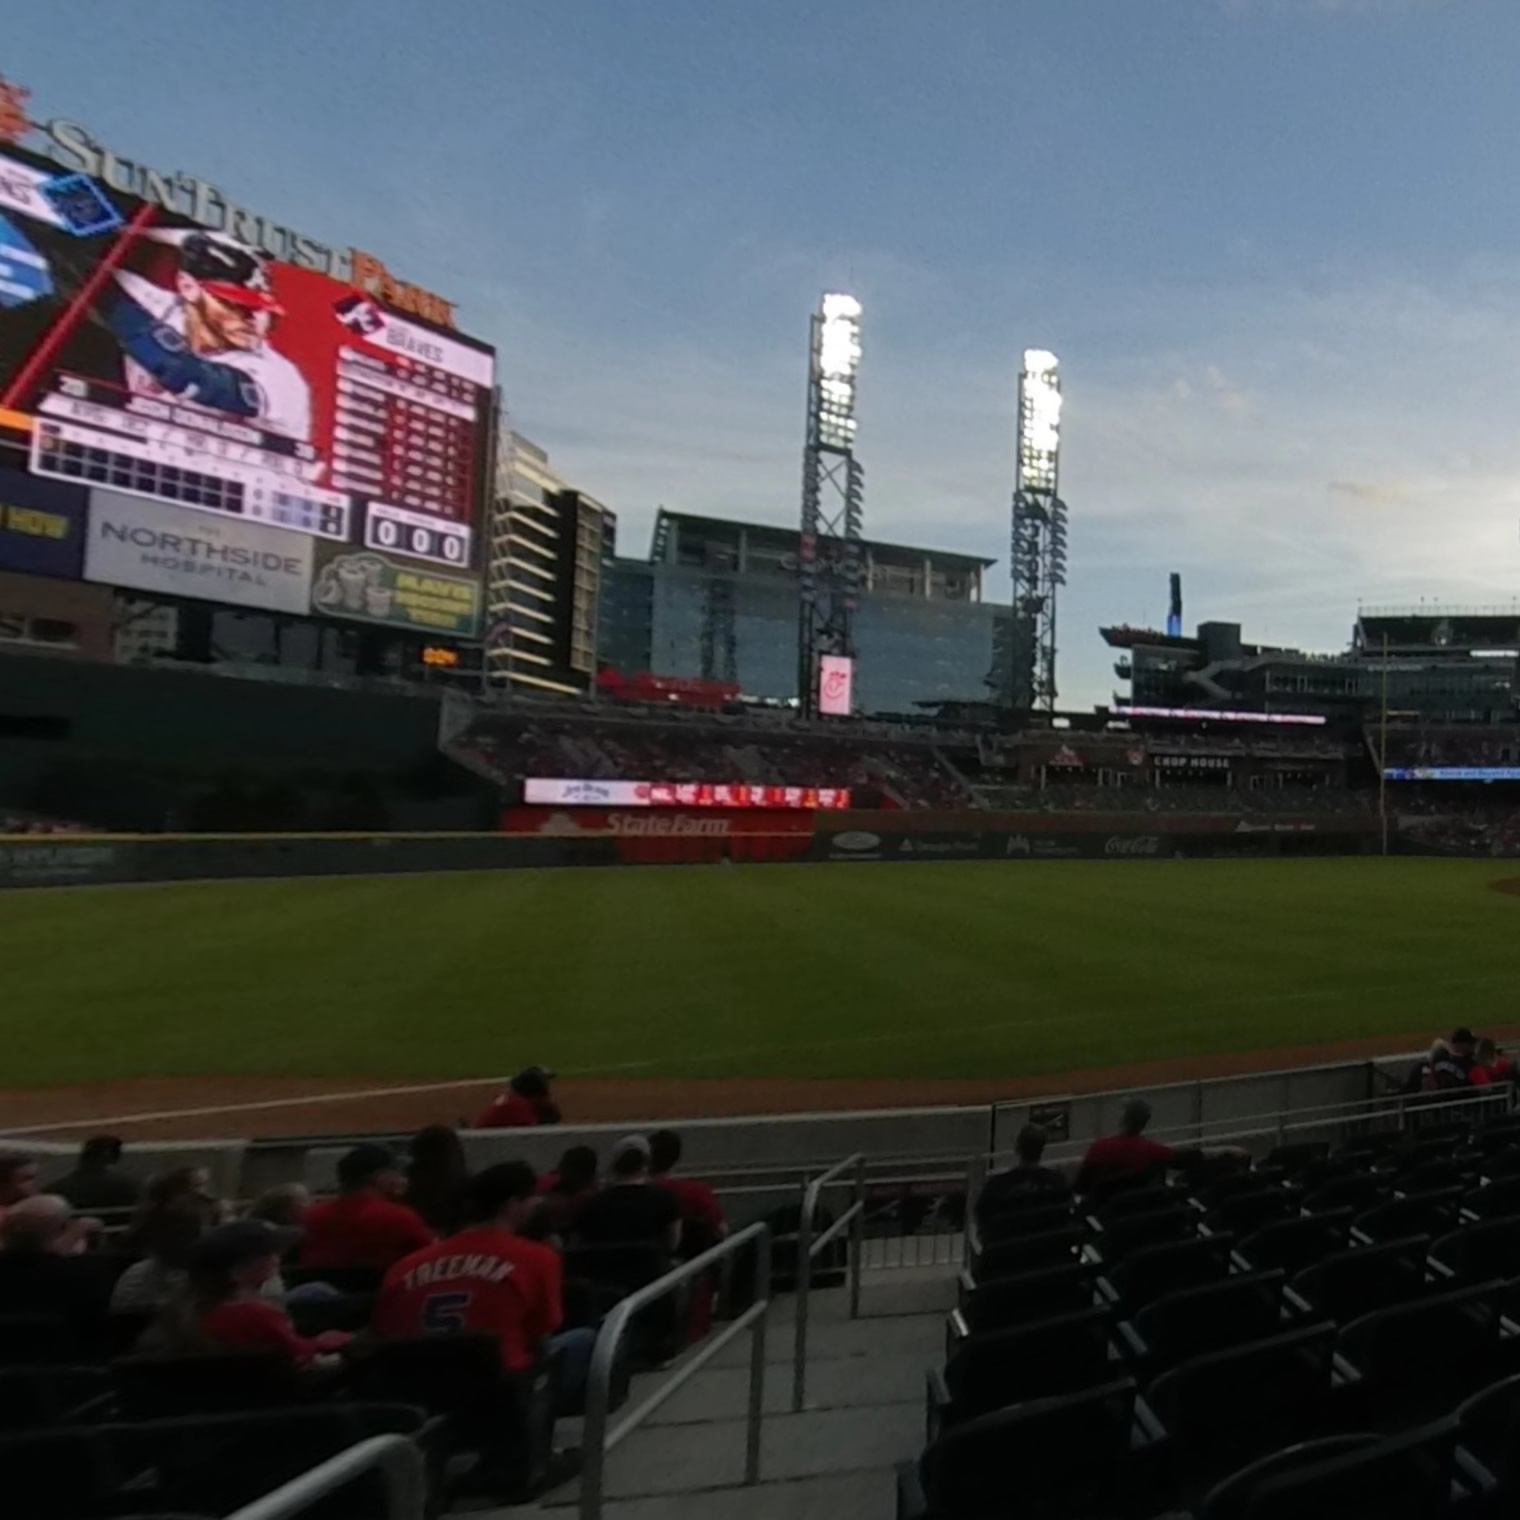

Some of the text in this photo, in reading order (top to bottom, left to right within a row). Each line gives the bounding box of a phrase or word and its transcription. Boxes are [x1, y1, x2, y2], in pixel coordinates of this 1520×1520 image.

[100, 521, 303, 576] NORTHSIDE
[378, 520, 461, 560] 0 0 0
[141, 552, 267, 588] HOSPITAL
[1154, 756, 1230, 769] CHOP HOUSE
[422, 1290, 473, 1330] 5
